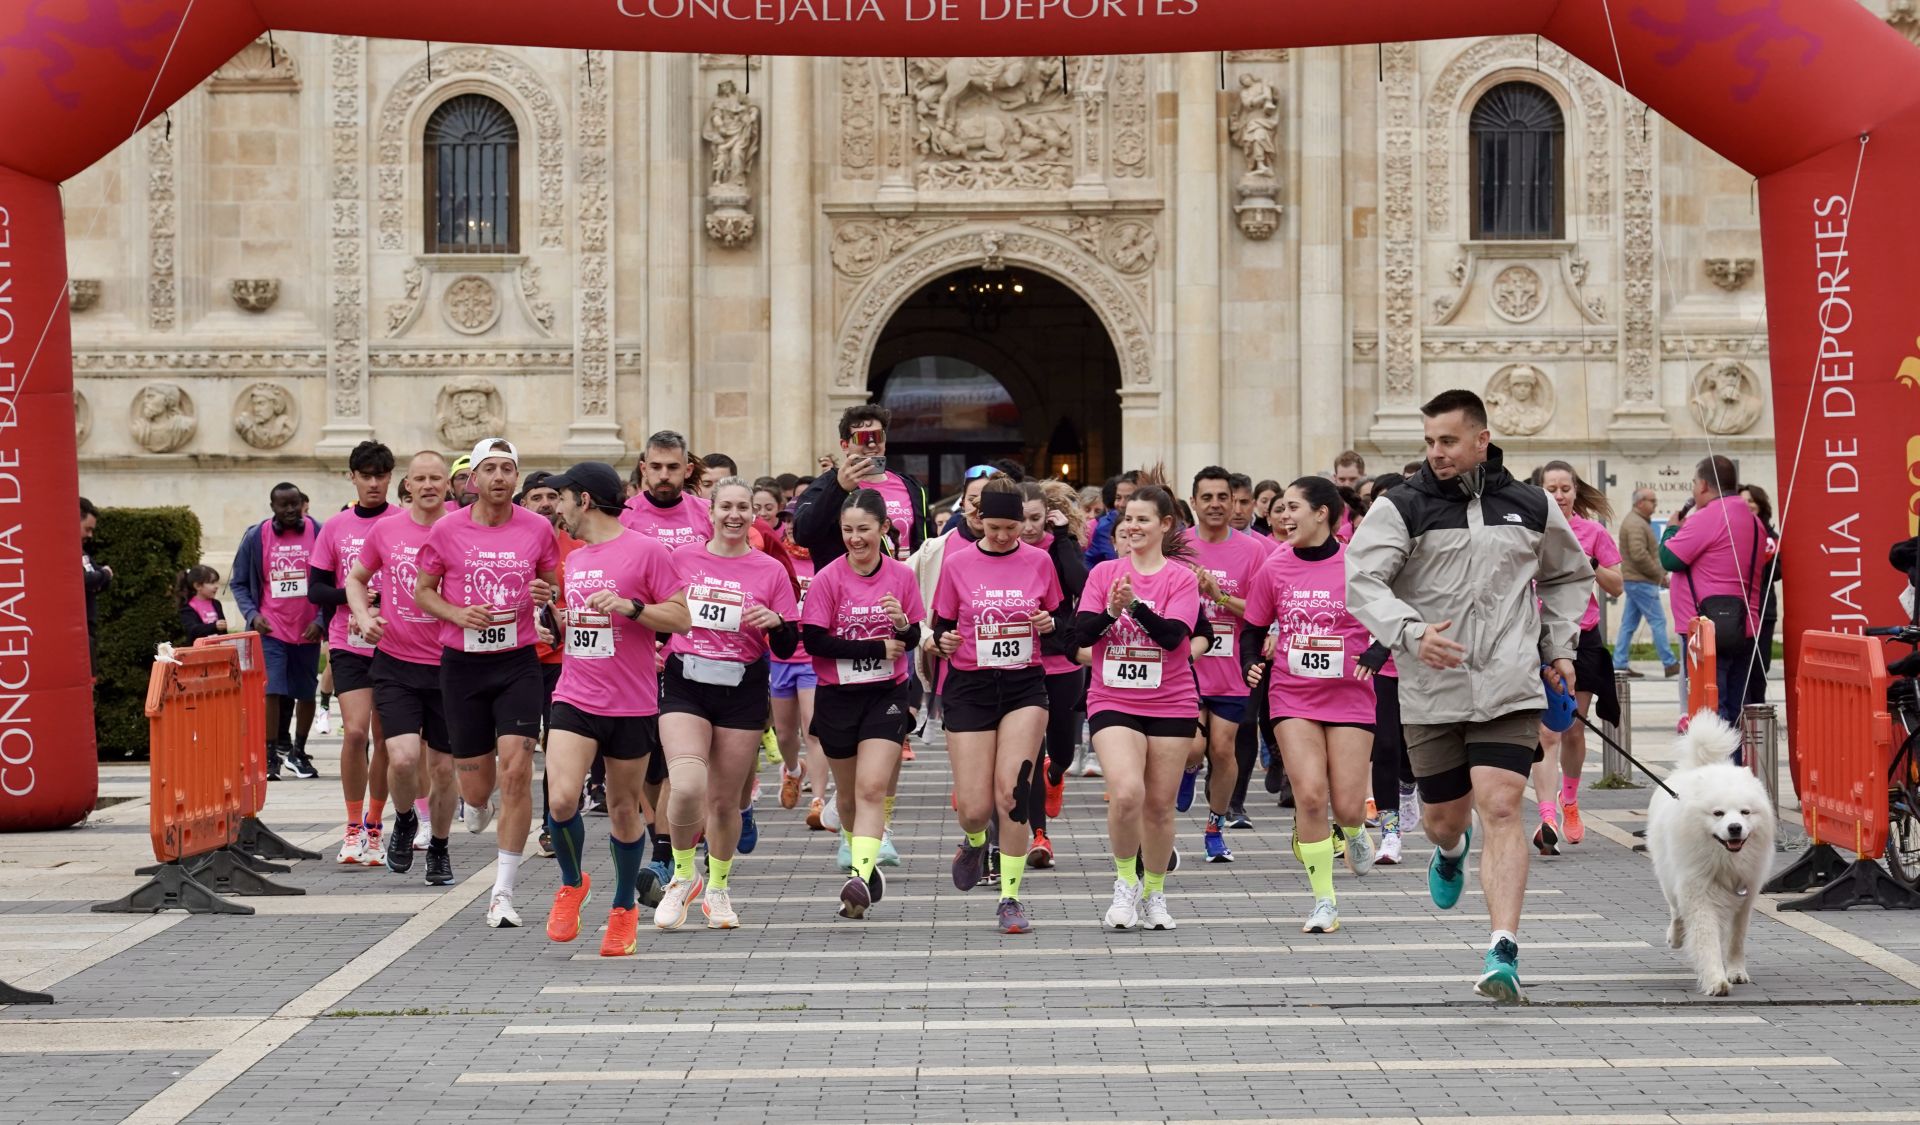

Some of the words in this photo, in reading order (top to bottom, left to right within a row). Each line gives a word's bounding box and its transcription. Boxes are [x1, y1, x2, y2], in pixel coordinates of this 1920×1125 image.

[905, 0, 959, 21] DE
[1814, 195, 1856, 418] DEPORTES
[1826, 437, 1860, 493] DE
[0, 448, 21, 504] DE
[658, 528, 674, 536] RUN
[676, 526, 693, 535] FOR
[478, 551, 496, 559] RUN
[498, 551, 516, 559] FOR
[588, 570, 603, 578] FOR
[280, 581, 298, 592] 275
[464, 573, 472, 605] 202
[704, 576, 722, 586] RUN
[723, 580, 741, 590] FOR
[986, 590, 1003, 598] RUN
[1005, 590, 1023, 598] FOR
[1293, 590, 1310, 599] RUN
[1312, 590, 1330, 599] FOR
[699, 604, 726, 622] 431
[851, 606, 868, 614] RUN
[478, 628, 506, 643] 396
[981, 624, 999, 634] RUN
[574, 630, 599, 647] 397
[992, 640, 1020, 658] 433
[852, 658, 882, 673] 432
[1301, 653, 1330, 670] 435
[1117, 663, 1147, 680] 434
